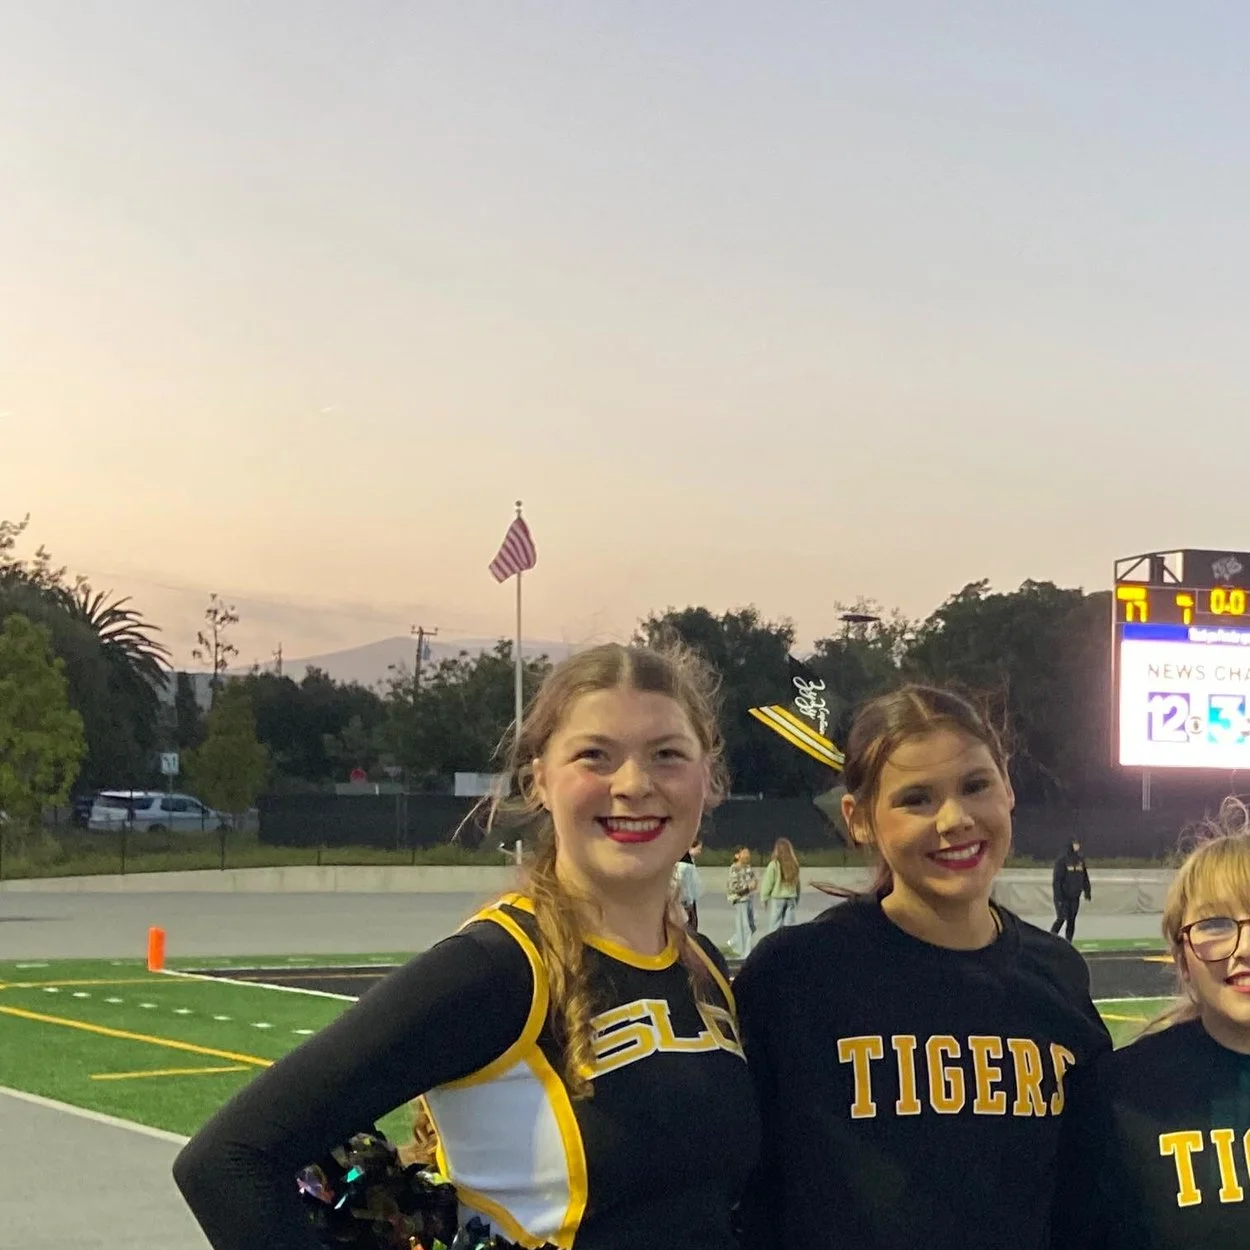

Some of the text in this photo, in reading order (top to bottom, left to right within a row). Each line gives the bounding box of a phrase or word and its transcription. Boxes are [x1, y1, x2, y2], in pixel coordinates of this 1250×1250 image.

[1148, 664, 1206, 681] NEWS
[1147, 693, 1190, 743] 12
[837, 1035, 1076, 1119] TIGERS
